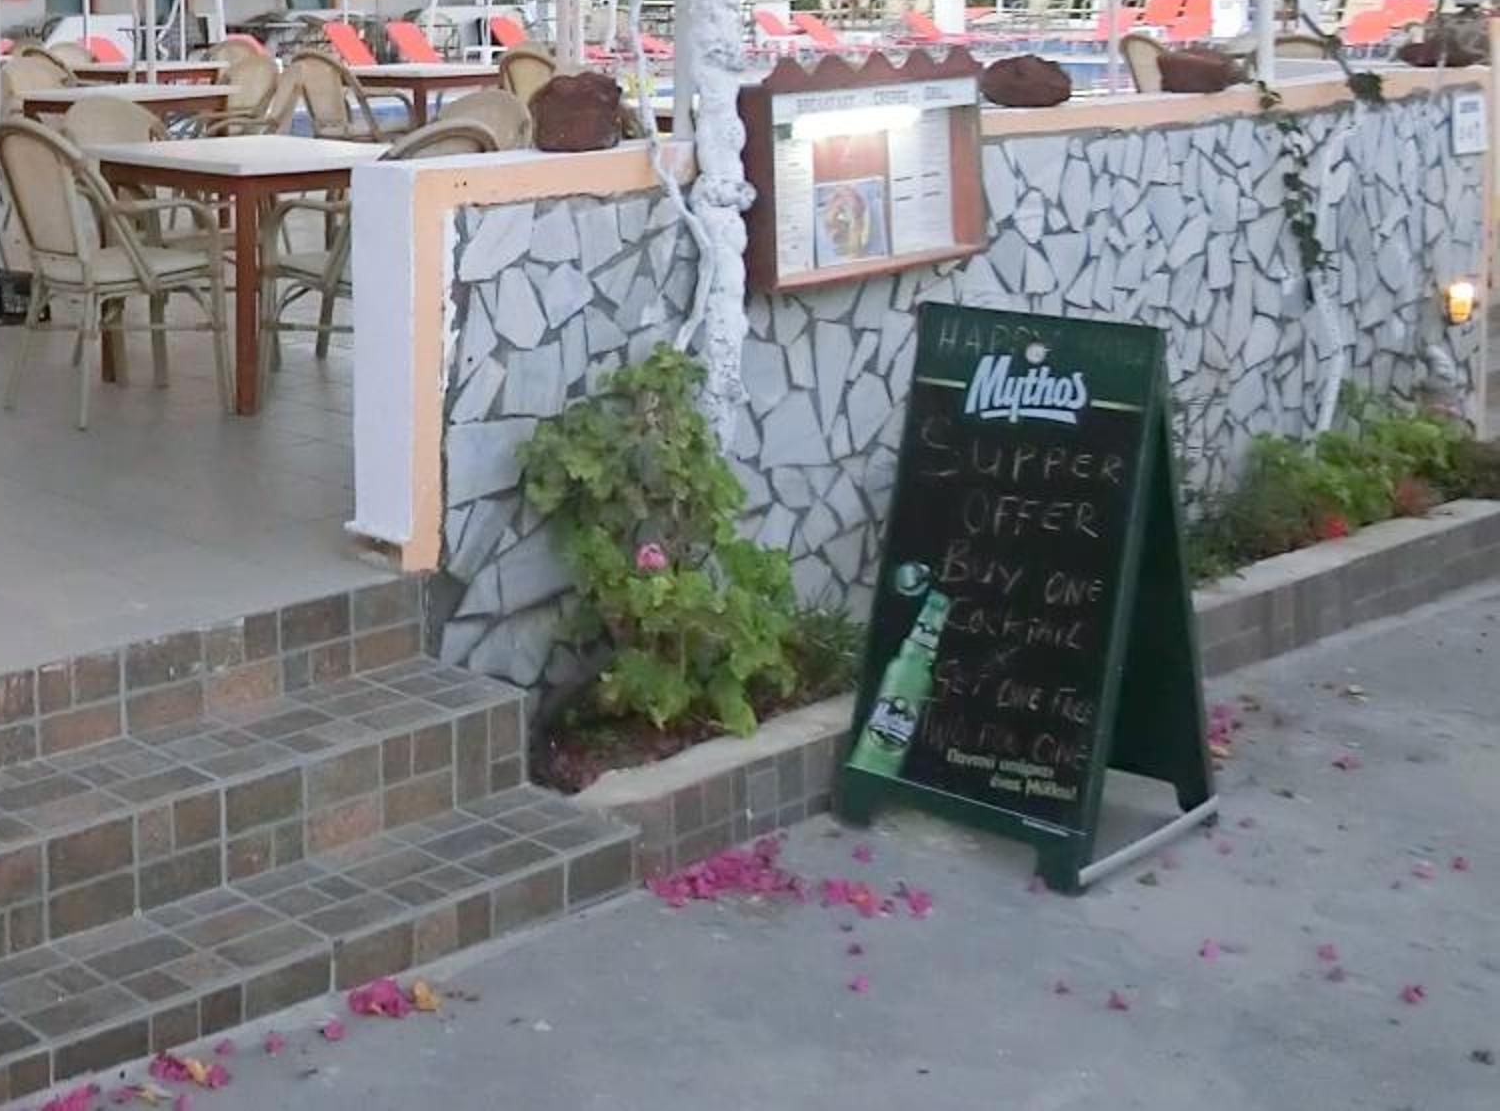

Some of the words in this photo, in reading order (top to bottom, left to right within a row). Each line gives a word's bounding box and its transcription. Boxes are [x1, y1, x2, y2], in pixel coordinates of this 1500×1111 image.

[964, 354, 1088, 424] Mythos
[919, 416, 1126, 485] SUPPER
[963, 490, 1099, 538] OFFER
[1043, 571, 1103, 605] ONE
